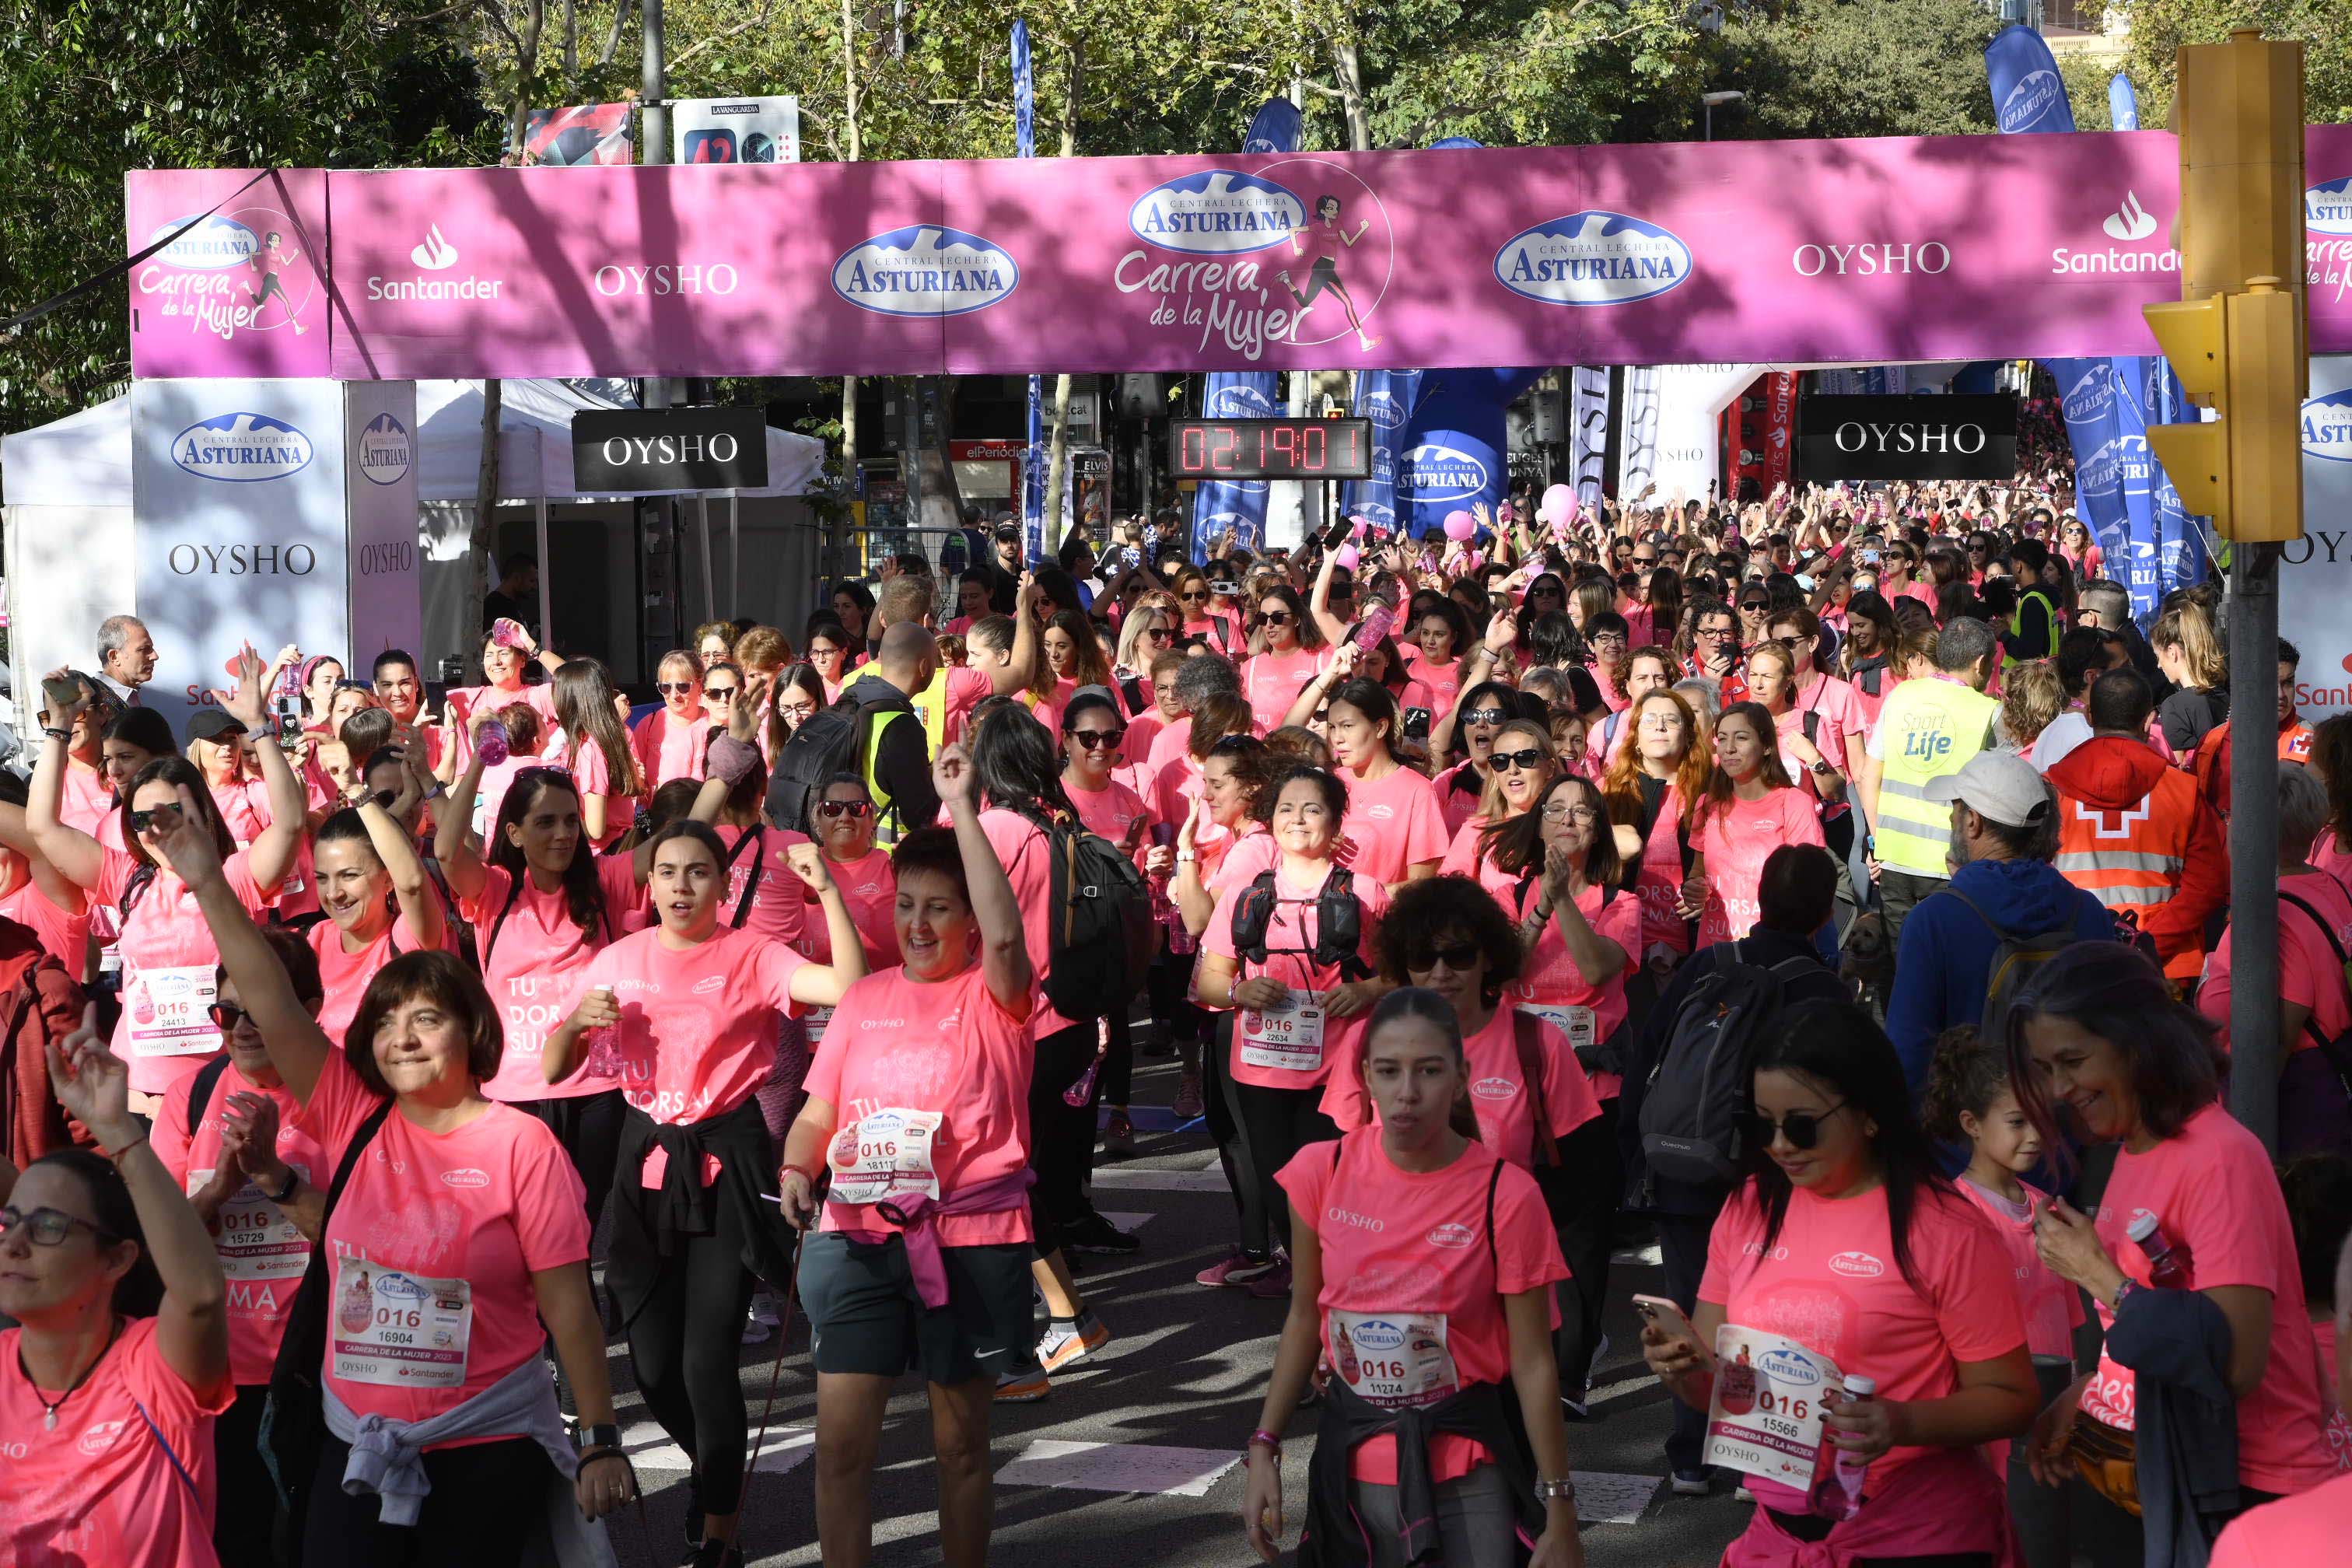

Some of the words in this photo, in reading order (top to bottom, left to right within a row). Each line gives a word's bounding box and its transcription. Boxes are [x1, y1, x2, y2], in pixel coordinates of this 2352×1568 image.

[1169, 198, 1225, 208] CENTRAL
[1230, 197, 1288, 207] LECHERA
[1143, 201, 1295, 233] ASTURIANA
[1539, 243, 1601, 254] CENTRAL
[1606, 243, 1671, 253] LECHERA
[874, 256, 933, 266] CENTRAL
[939, 255, 998, 265] LECHERA
[1508, 247, 1677, 282] ASTURIANA
[1792, 242, 1951, 276] OYSHO
[2052, 249, 2182, 274] Santand
[138, 265, 230, 295] Carrera
[594, 264, 739, 297] OYSHO
[845, 259, 1005, 293] ASTURIANA
[1114, 250, 1261, 294] Carrera
[367, 275, 503, 301] Santander
[161, 298, 177, 317] de
[182, 296, 194, 317] la
[192, 292, 265, 340] Mujer
[1150, 296, 1177, 326] de
[1183, 294, 1202, 326] la
[1198, 288, 1316, 361] Mujer
[1834, 421, 1986, 454] OYSHO
[182, 438, 303, 465] ASTURIANA
[362, 440, 408, 468] ASTURIANA
[602, 432, 739, 467] OYSHO
[1181, 427, 1357, 471] 02:19:01
[1084, 460, 1108, 471] ELVIS
[2280, 530, 2352, 565] OY
[169, 544, 316, 576] OYSHO
[360, 541, 412, 576] OYSHO
[1900, 712, 1947, 733] Sport
[1904, 730, 1951, 762] Life
[516, 908, 538, 922] OYS
[507, 977, 537, 996] TU
[618, 979, 660, 993] OYSHO
[158, 1002, 189, 1015] 016
[162, 1017, 186, 1027] 24413
[1265, 1019, 1293, 1031] 016
[1266, 1034, 1288, 1042] 22634
[861, 1141, 897, 1157] 016
[1661, 1139, 1691, 1151] Quechua
[866, 1160, 894, 1170] 18117
[224, 1211, 268, 1230] 016
[1328, 1206, 1384, 1234] OYSHO
[231, 1232, 264, 1244] 15729
[235, 1247, 247, 1256] DE
[247, 1246, 257, 1255] LA
[257, 1245, 283, 1254] MUJER
[267, 1259, 306, 1271] Santander
[376, 1307, 421, 1328] 016
[379, 1331, 414, 1345] 16904
[1356, 1330, 1402, 1344] ASTURIANA
[345, 1344, 379, 1355] CARRERA
[380, 1348, 391, 1356] DE
[391, 1348, 403, 1357] LA
[403, 1349, 432, 1360] MUJER
[434, 1352, 453, 1361] 2023
[341, 1361, 378, 1374] OYSHO
[410, 1367, 455, 1380] Santander
[1363, 1360, 1405, 1378] 016
[1762, 1359, 1816, 1382] ASTURIANA
[1370, 1382, 1403, 1395] 11274
[1398, 1396, 1425, 1406] MUJER
[1759, 1390, 1808, 1419] 016
[1762, 1417, 1799, 1437] 15566
[1721, 1425, 1762, 1442] CARRERA
[1763, 1437, 1775, 1446] DE
[1775, 1439, 1786, 1449] LA
[1786, 1443, 1815, 1458] MUJER
[1714, 1444, 1760, 1464] OYSHO
